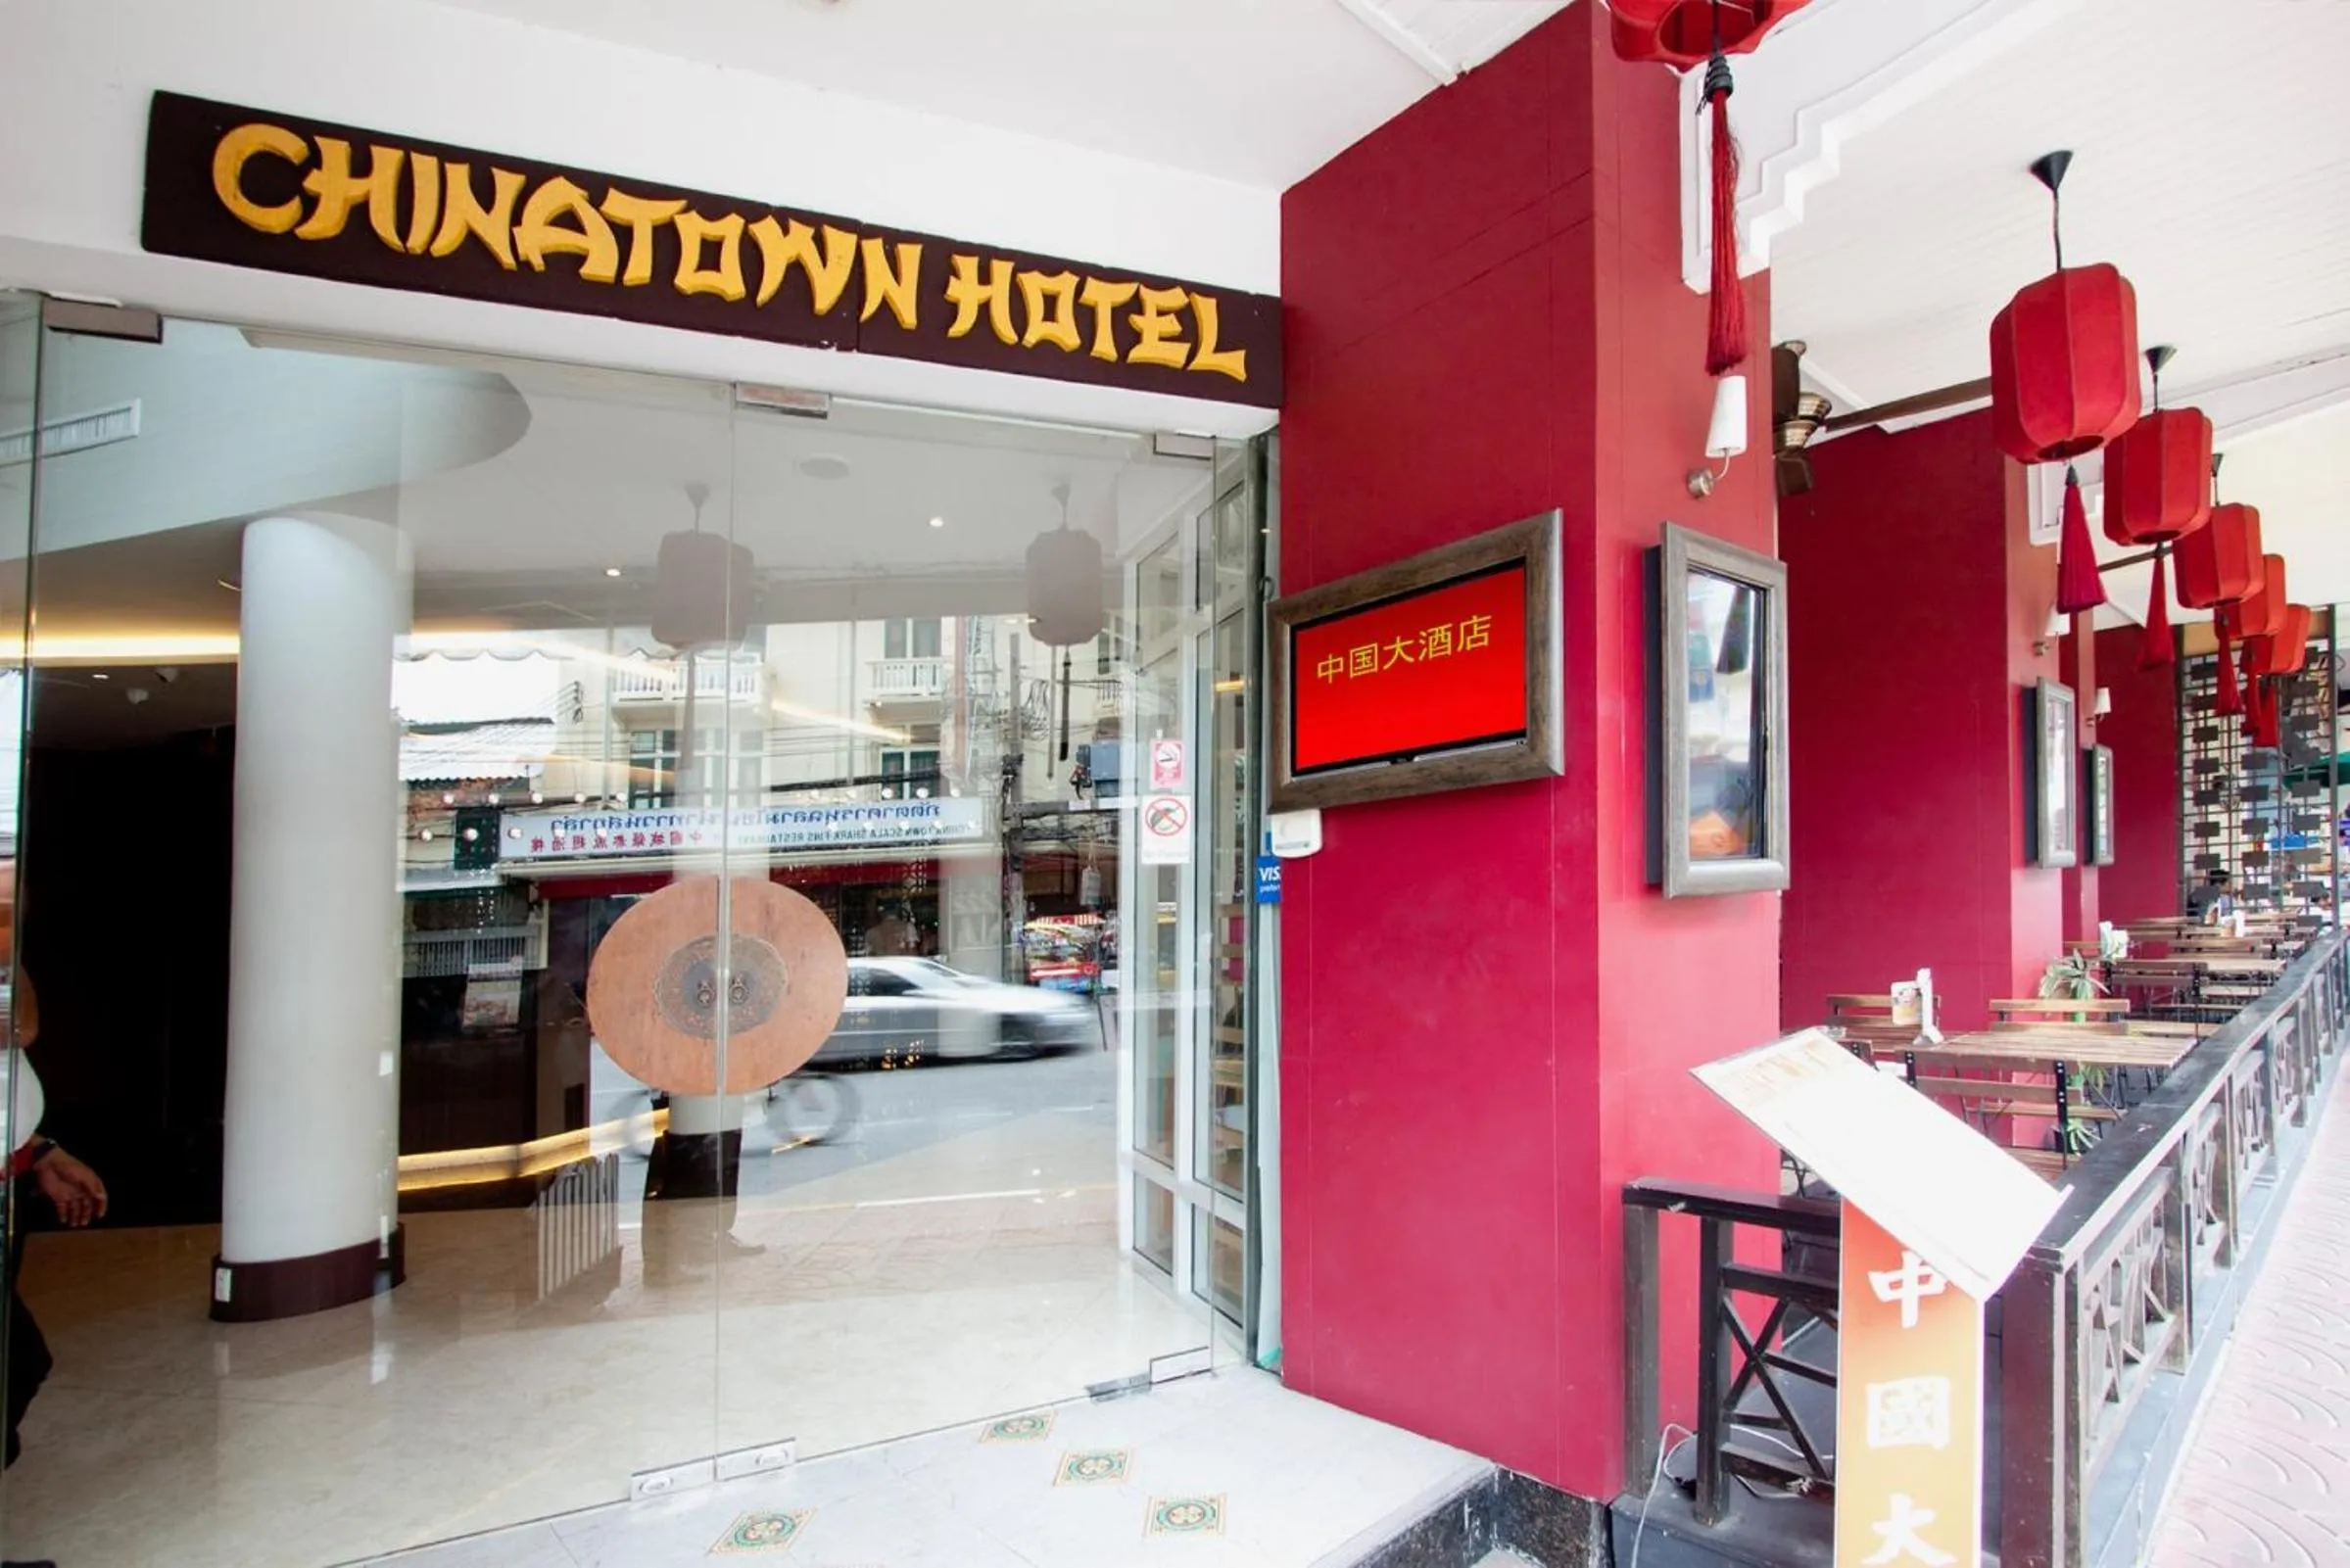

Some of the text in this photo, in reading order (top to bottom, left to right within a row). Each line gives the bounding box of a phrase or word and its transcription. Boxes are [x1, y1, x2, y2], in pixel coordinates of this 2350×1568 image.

[212, 122, 1247, 383] CHINATOWN HOTEL
[1316, 613, 1493, 685] 中国大酒店
[1259, 866, 1281, 881] VIS
[1862, 1251, 1957, 1567] 中國大
